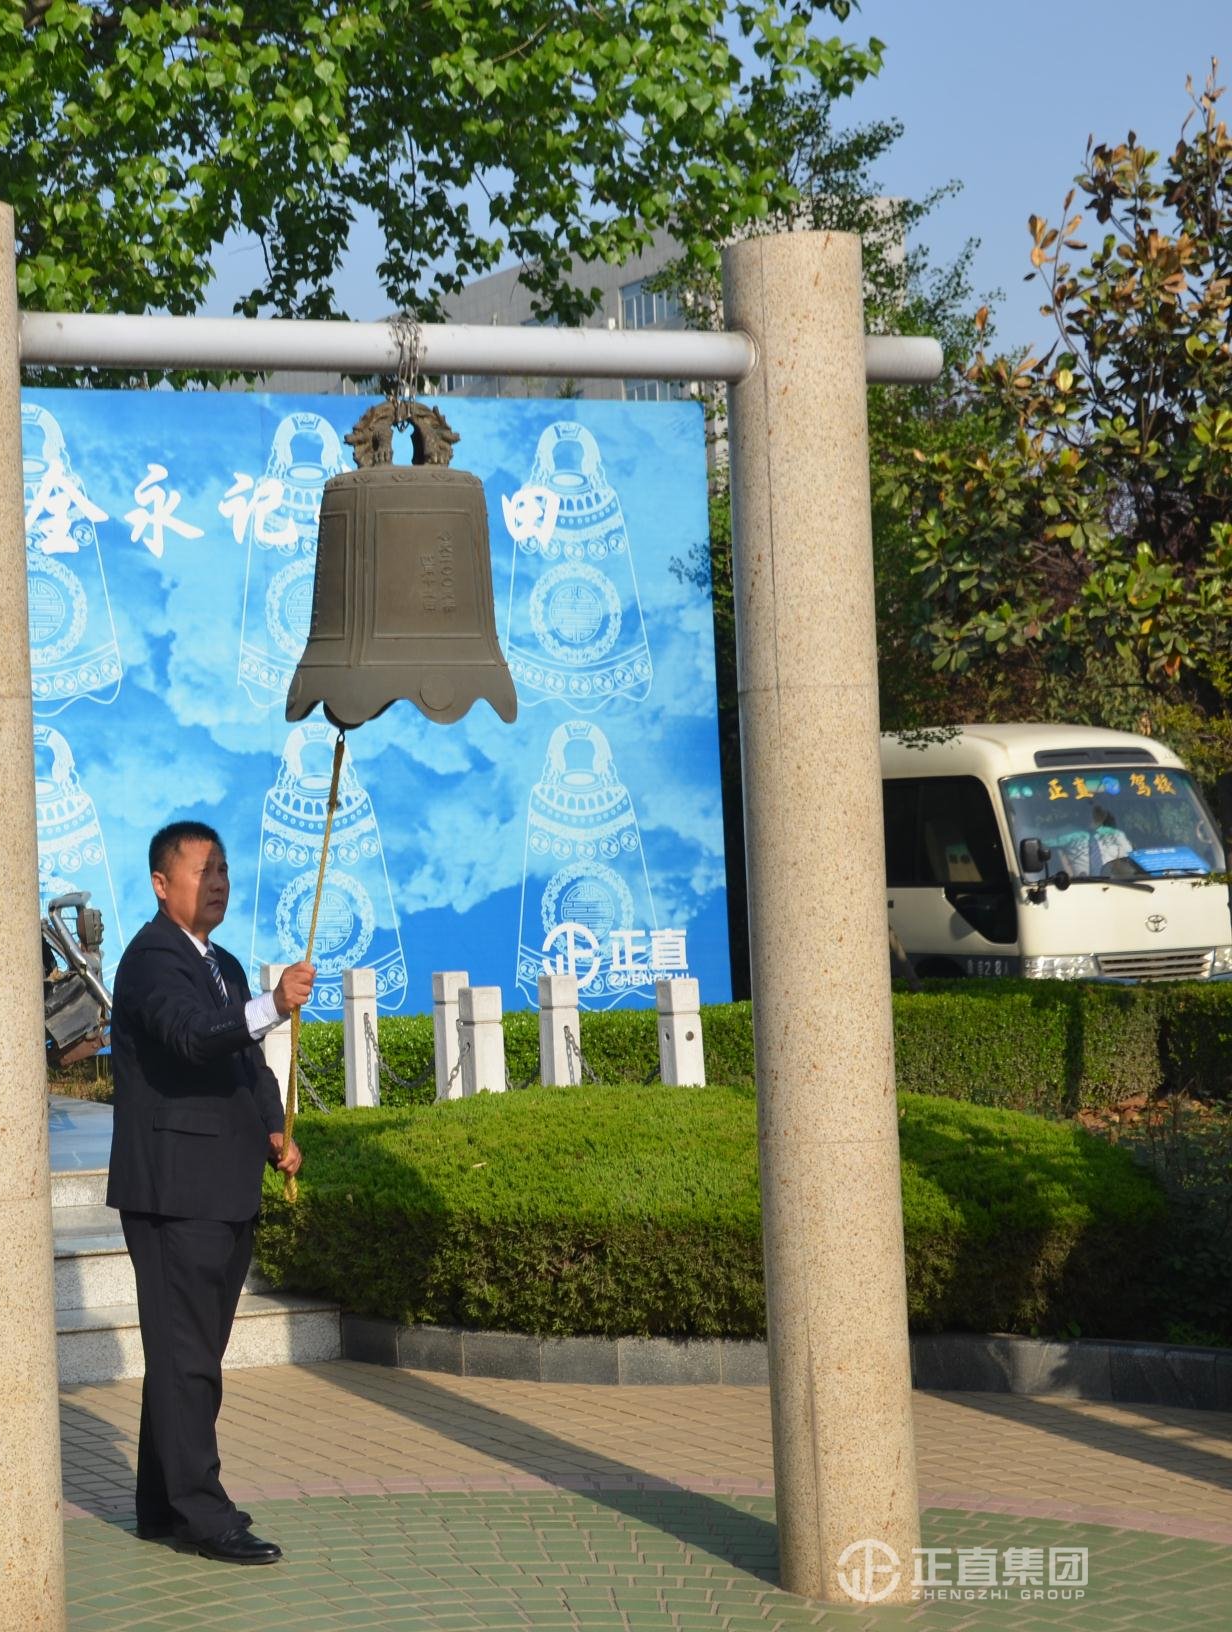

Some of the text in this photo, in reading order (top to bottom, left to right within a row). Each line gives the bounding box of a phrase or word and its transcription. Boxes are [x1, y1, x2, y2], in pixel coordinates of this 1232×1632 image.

[24, 459, 560, 558] 全永记田
[1048, 773, 1176, 800] 正直驾校
[609, 928, 688, 971] 正直
